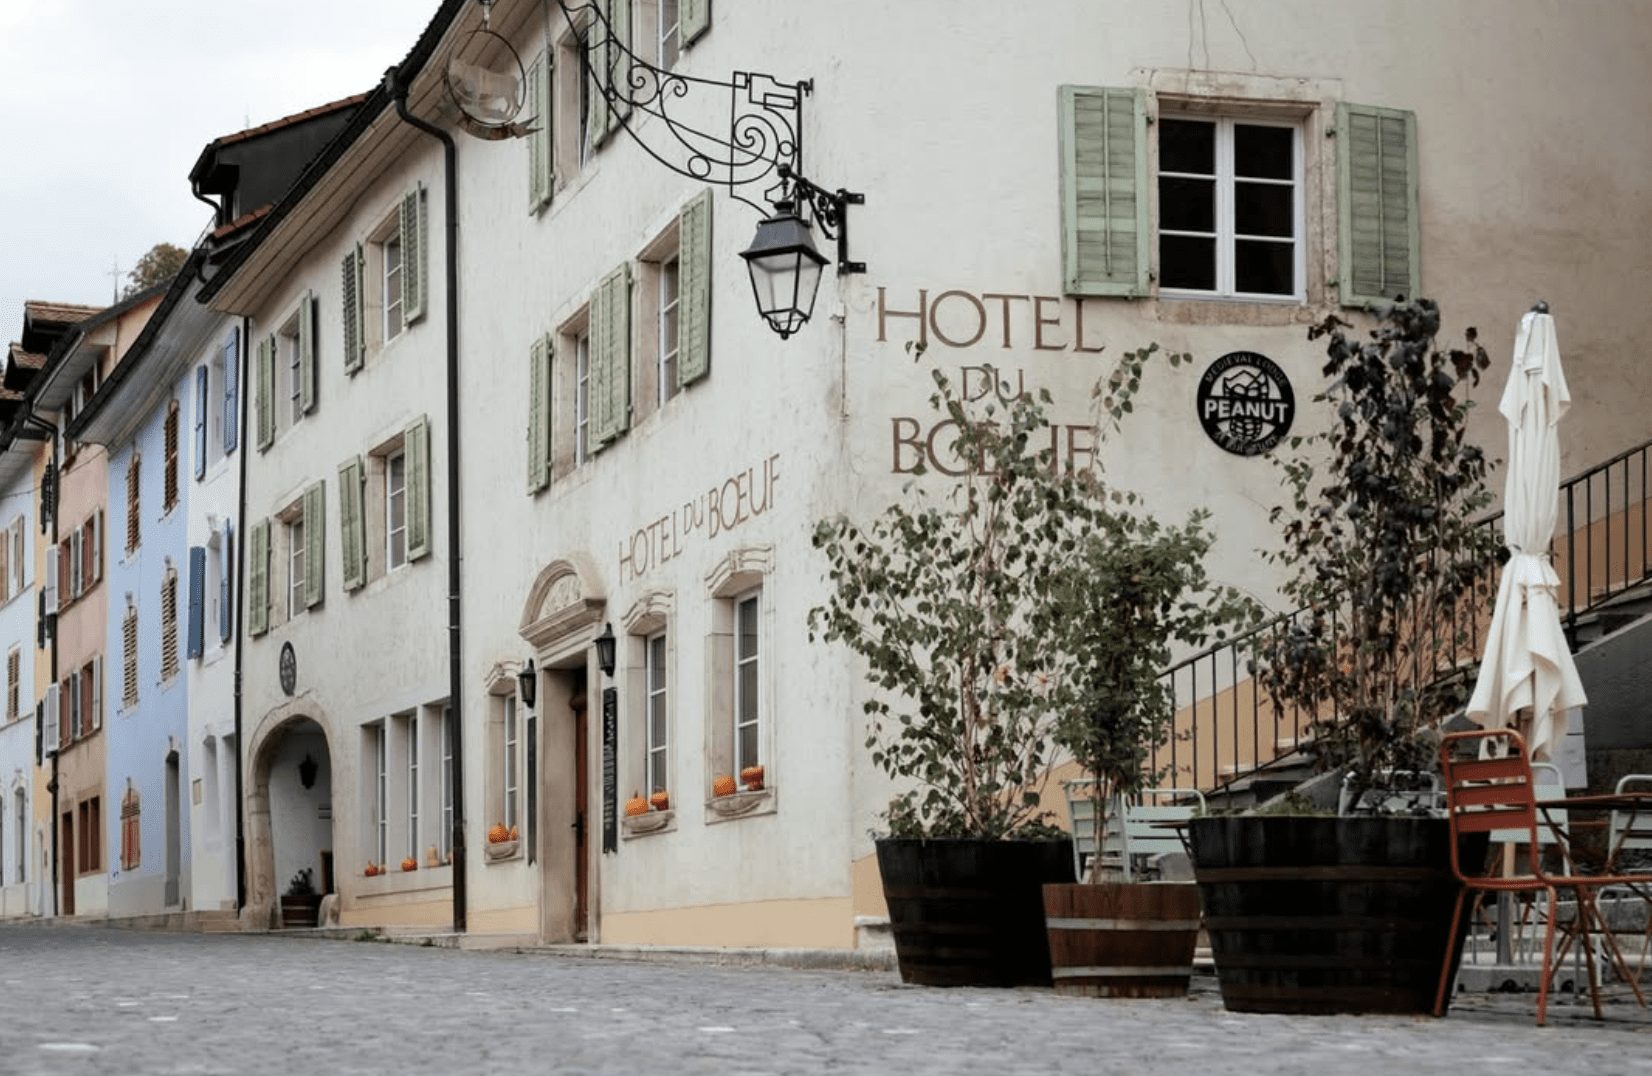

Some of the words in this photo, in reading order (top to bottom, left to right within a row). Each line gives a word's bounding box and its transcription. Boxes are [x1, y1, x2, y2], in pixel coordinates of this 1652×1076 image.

[877, 287, 1106, 353] HOTEL
[961, 366, 1024, 401] DU
[1205, 354, 1252, 383] MEDIEVAL
[1204, 398, 1289, 424] PEANUT
[619, 511, 683, 587] HOTEL
[683, 495, 704, 535] DU
